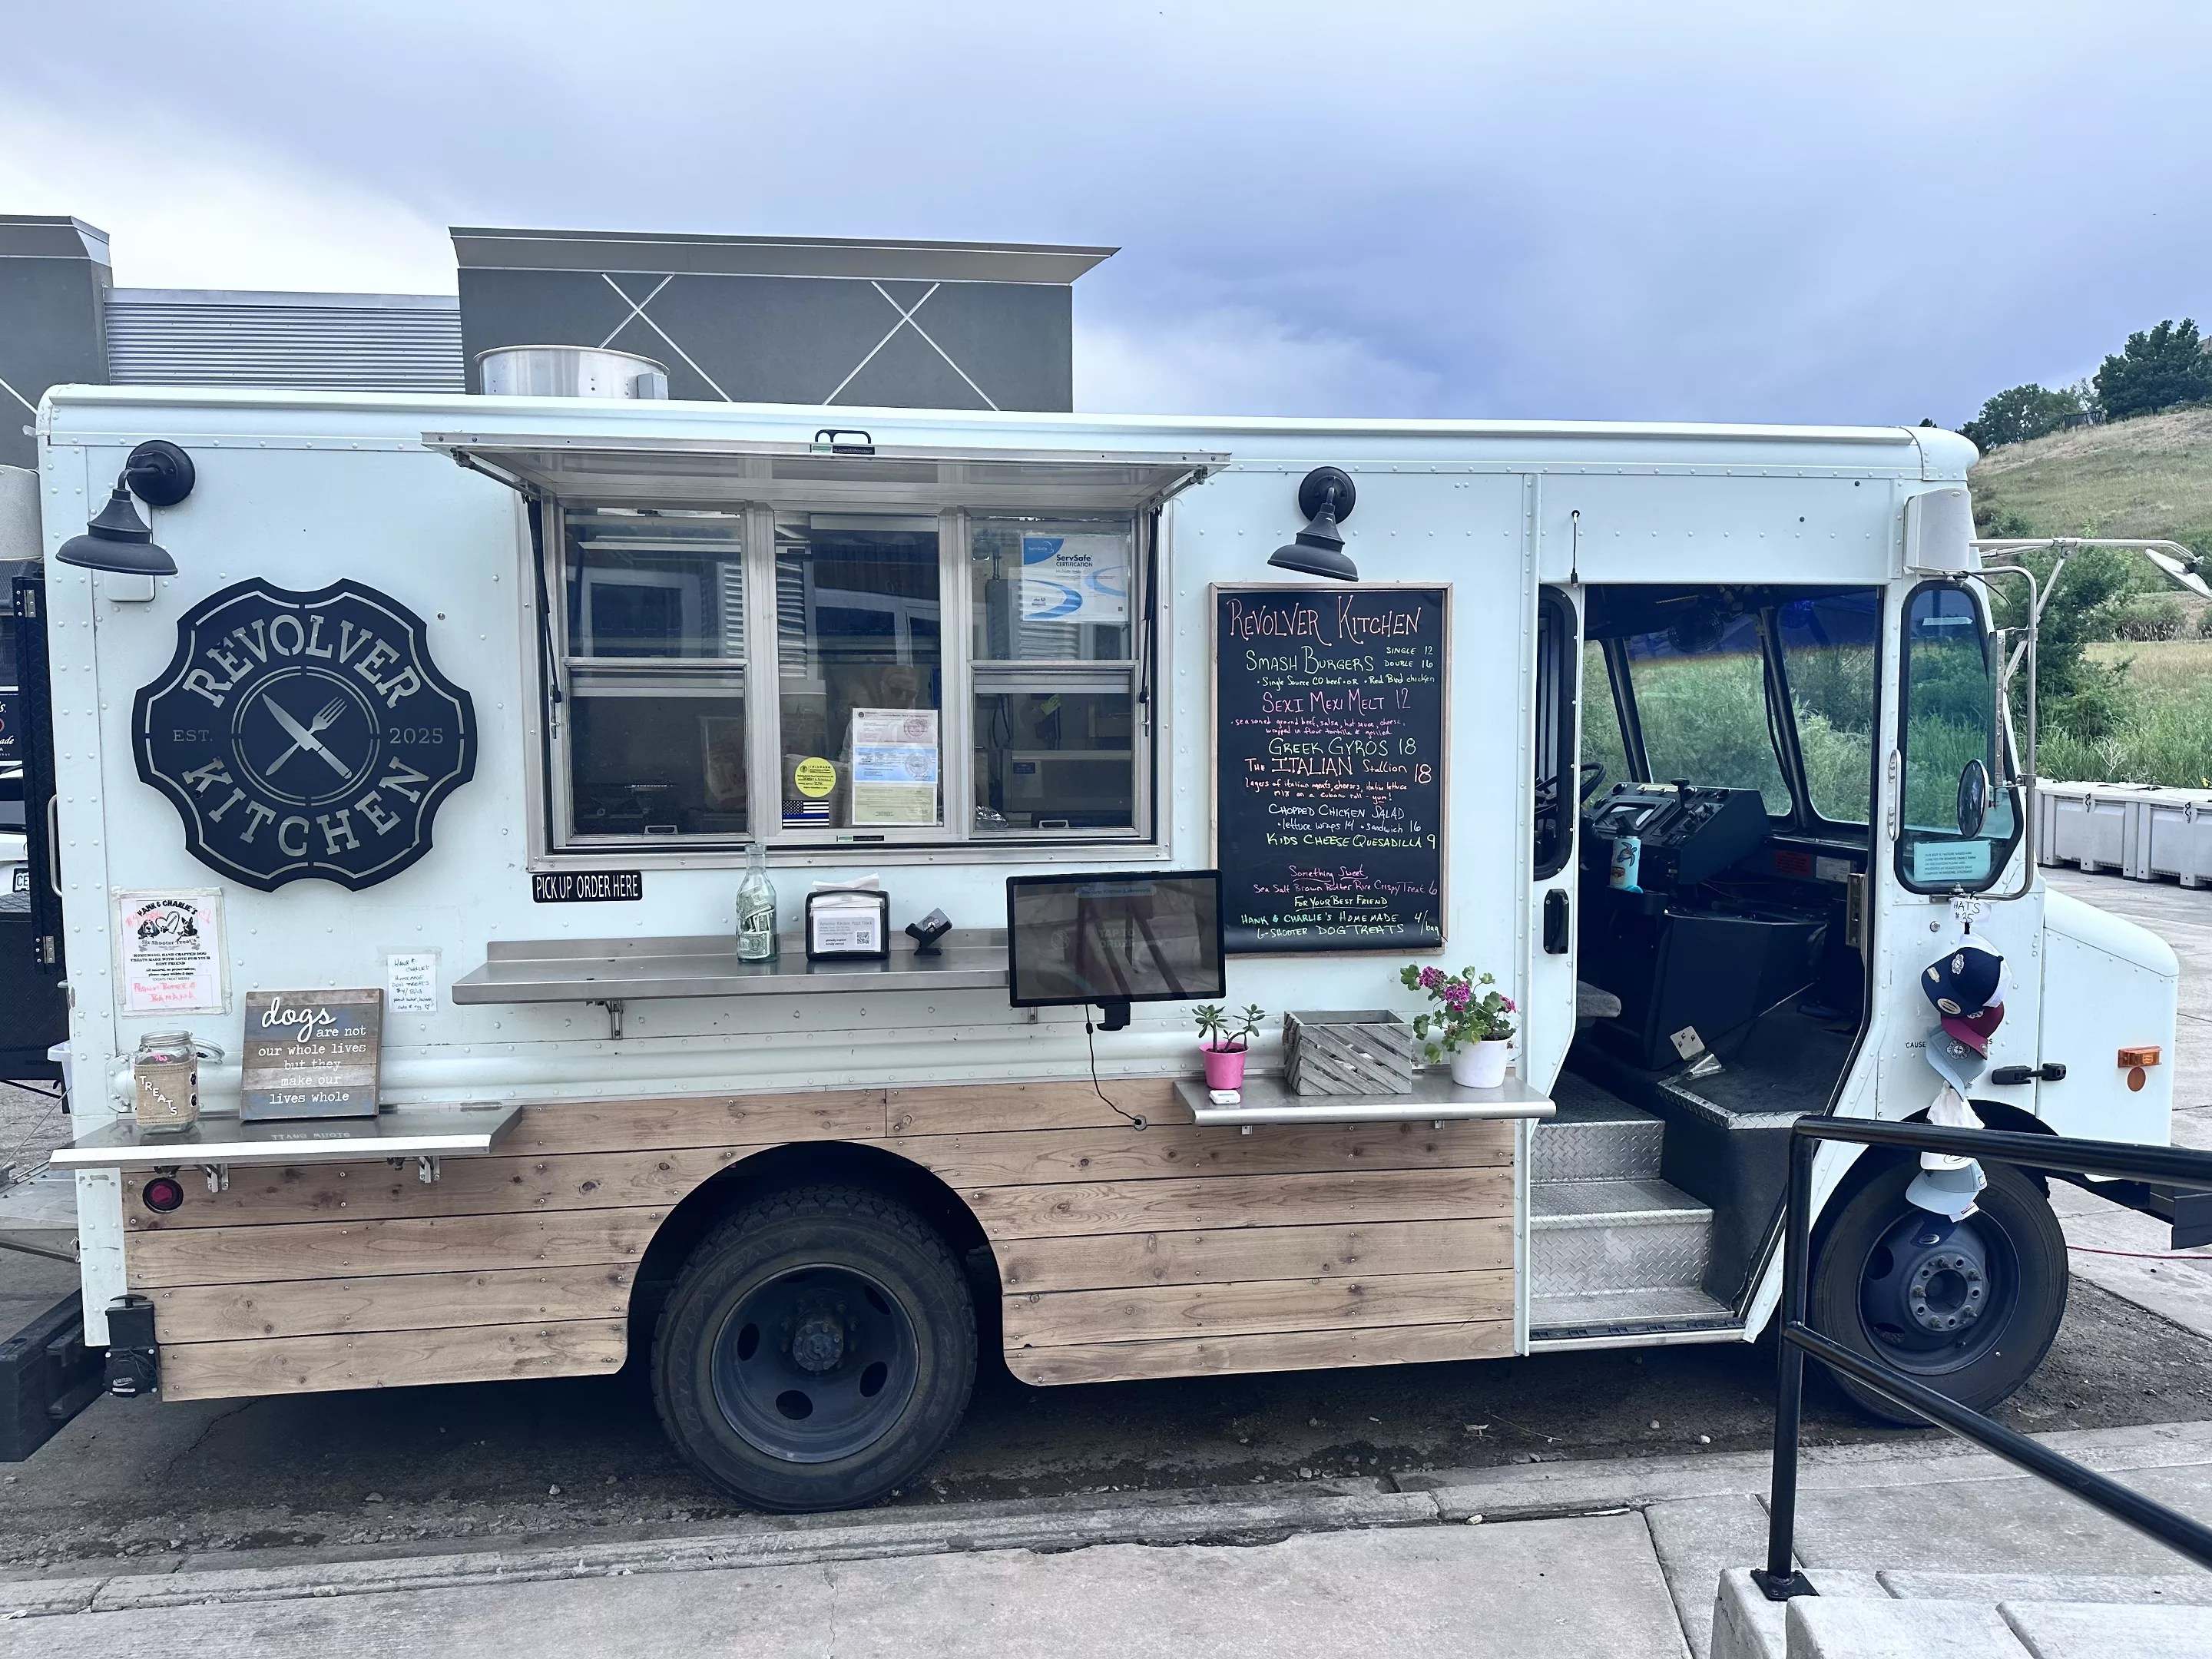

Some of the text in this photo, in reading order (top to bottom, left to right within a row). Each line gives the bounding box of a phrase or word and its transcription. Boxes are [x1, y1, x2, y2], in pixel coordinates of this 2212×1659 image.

[1227, 594, 1421, 646] REVOLVER KITCHEN
[1425, 646, 1433, 654] 12
[183, 614, 421, 709] REVOLVER
[1246, 645, 1374, 674] SMASH BURGERS
[1263, 677, 1283, 691] Single
[1287, 675, 1309, 686] Source
[1406, 673, 1435, 683] chicken
[1263, 688, 1411, 716] SEXI MEXI MELT 12
[1277, 718, 1299, 727] ground
[1320, 718, 1342, 728] salsa,
[1344, 719, 1356, 727] hot
[173, 729, 213, 743] EST.
[389, 727, 443, 744] 2025
[1365, 729, 1392, 739] grilled
[1269, 737, 1416, 759] GREEK GYROS 18
[1245, 757, 1432, 783] THE ITALIAN Stallion 18
[1273, 779, 1282, 788] of
[1386, 780, 1407, 790] lettuce
[184, 757, 429, 857] KITCHEN
[1268, 803, 1405, 820] CHOPPED CHICKEN SALAD
[1315, 822, 1340, 831] wraps
[1345, 820, 1355, 830] 14
[1366, 822, 1402, 833] sandwich
[1409, 820, 1421, 833] 16
[1267, 833, 1435, 849] KIDS CHEESE QUESADILLA 9
[1289, 864, 1366, 884] Something Sweet
[537, 875, 638, 899] PICK UP ORDER HERE
[1253, 881, 1438, 896] Sea Salt Brown Butter Rice Crispy Treat 6
[137, 902, 157, 916] HANK
[163, 900, 198, 915] CHARLIE'S
[1294, 896, 1387, 907] FOR YOUR BEST FRIEND
[1953, 901, 1981, 915] HATS
[1241, 915, 1269, 925] HANK
[1283, 912, 1333, 922] CHARLIE'S
[1257, 924, 1404, 939] 6-SHOOTER DOG TREATS
[261, 997, 337, 1043] dogs
[316, 1025, 366, 1037] are not
[259, 1043, 366, 1056] our whole lives
[284, 1059, 341, 1071] but they
[281, 1076, 342, 1087] make our
[139, 1075, 177, 1116] TREATS
[270, 1091, 349, 1104] lives whole
